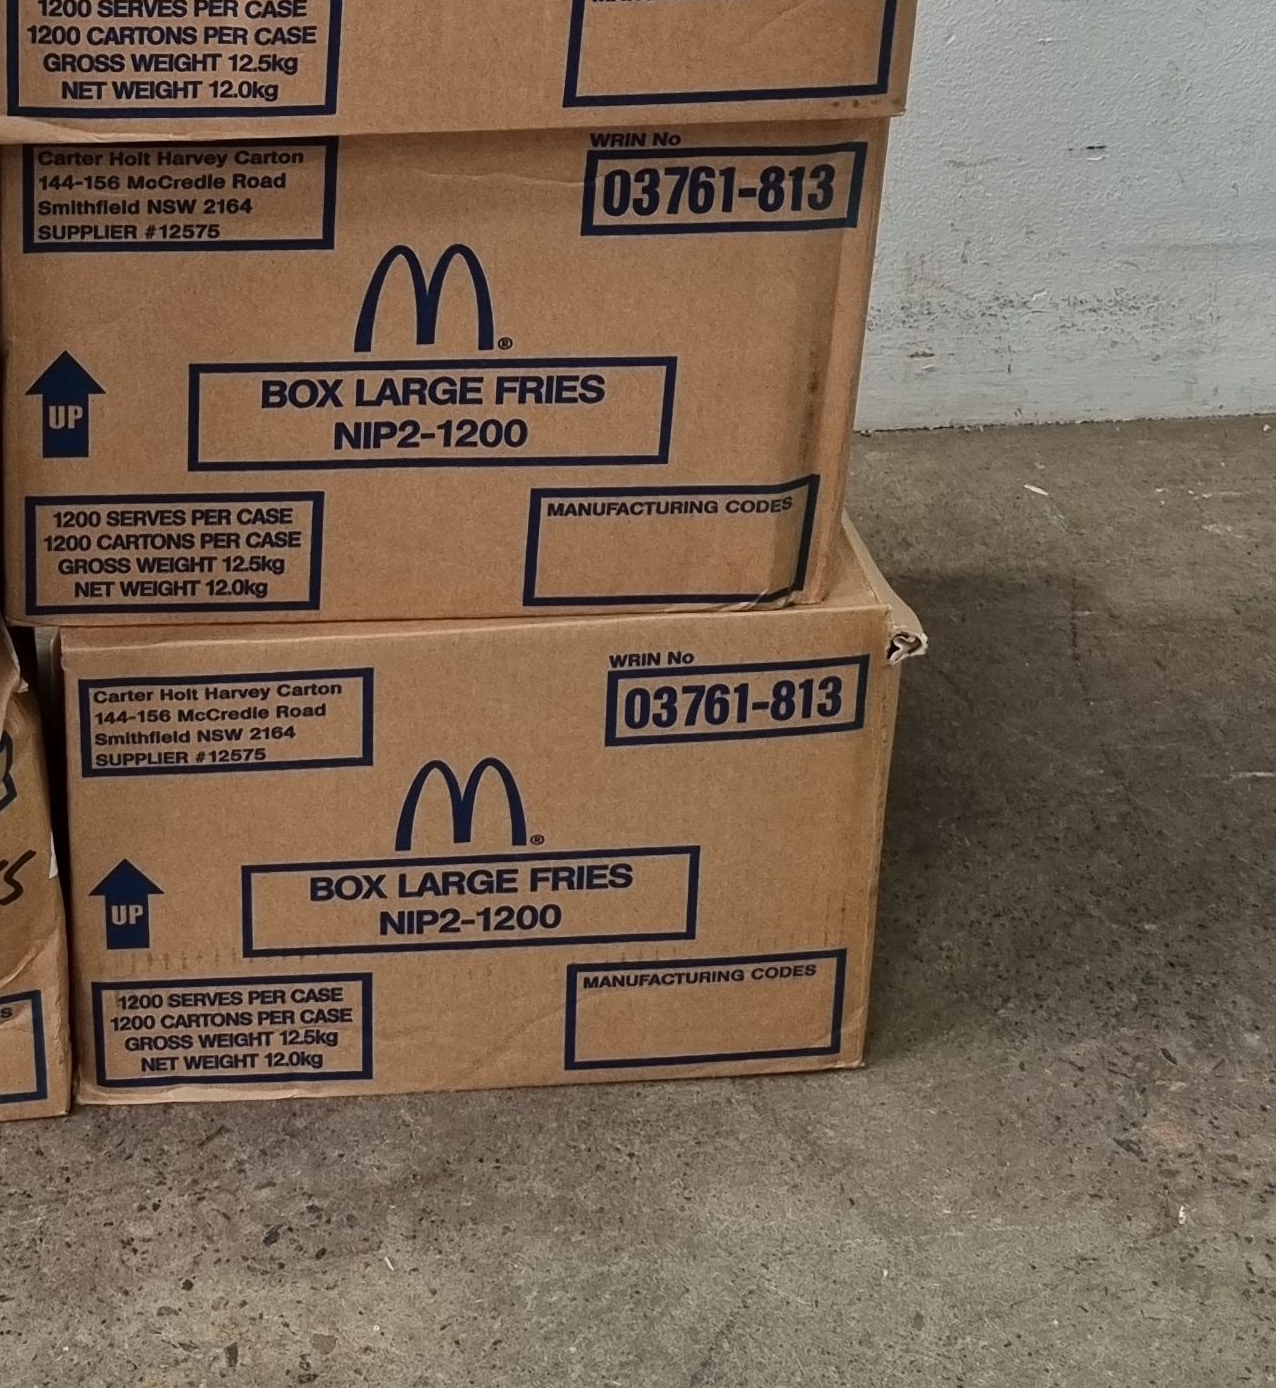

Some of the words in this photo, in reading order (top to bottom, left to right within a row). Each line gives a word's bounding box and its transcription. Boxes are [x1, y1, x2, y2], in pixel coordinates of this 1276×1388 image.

[97, 0, 187, 18] SERVES
[194, 0, 238, 18] PER
[245, 0, 307, 18] CASE
[27, 26, 80, 45] 1200
[87, 26, 197, 45] CARTONS
[203, 27, 248, 45] PER
[255, 27, 317, 45] CASE
[43, 54, 124, 72] GROSS
[131, 54, 222, 72] WEIGHT
[228, 55, 298, 75] 12.5kg
[62, 81, 106, 99] NET
[113, 81, 202, 99] WEIGHT
[209, 81, 278, 101] 12.0kg
[590, 133, 646, 147] WRIN
[652, 132, 681, 147] No
[37, 151, 102, 167] Carter
[110, 152, 150, 166] Holt
[157, 151, 227, 169] Harvey
[234, 150, 304, 164] Carton
[38, 175, 119, 191] 144-156
[127, 175, 225, 190] McCredie
[233, 173, 286, 189] Road
[602, 164, 836, 217] 03761-813
[37, 200, 139, 216] Smithfield
[147, 200, 197, 214] NSW
[203, 199, 253, 214] 2164
[38, 225, 137, 240] SUPPLIER
[145, 224, 220, 239] #12575
[261, 378, 343, 409] BOX
[355, 376, 484, 408] LARGE
[495, 374, 606, 405] FRIES
[48, 405, 83, 429] UP
[333, 419, 529, 450] NIP2-1200
[547, 500, 718, 518] MANUFACTURING
[725, 496, 793, 513] CODES
[53, 511, 101, 528] 1200
[106, 510, 186, 526] SERVES
[192, 509, 231, 525] PER
[237, 508, 293, 524] CASE
[43, 535, 91, 551] 1200
[97, 534, 195, 550] CARTONS
[201, 533, 240, 549] PER
[246, 532, 302, 548] CASE
[58, 558, 131, 574] GROSS
[136, 557, 217, 574] WEIGHT
[222, 556, 285, 574] 12.5kg
[74, 581, 114, 598] NET
[120, 580, 200, 597] WEIGHT
[206, 580, 268, 599] 12.0kg
[609, 652, 661, 669] WRIN
[667, 650, 695, 666] No
[93, 690, 153, 704] Carter
[160, 688, 198, 701] Holt
[205, 686, 270, 701] Harvey
[277, 683, 342, 697] Carton
[624, 676, 843, 730] 03761-813
[95, 710, 171, 725] 144-156
[178, 706, 269, 723] McCredie
[276, 704, 326, 718] Road
[95, 731, 191, 746] Smithfield
[197, 728, 243, 742] NSW
[250, 726, 296, 740] 2164
[95, 751, 188, 767] SUPPLIER
[195, 748, 266, 763] #12575
[310, 875, 387, 901] BOX
[398, 869, 519, 898] LARGE
[530, 864, 634, 892] FRIES
[111, 904, 143, 926] UP
[379, 904, 562, 936] NIP2-1200
[583, 968, 745, 990] MANUFACTURING
[751, 964, 818, 980] CODES
[119, 994, 163, 1010] 1200
[168, 992, 243, 1008] SERVES
[248, 990, 285, 1005] PER
[291, 987, 343, 1003] CASE
[110, 1015, 155, 1031] 1200
[161, 1012, 253, 1029] CARTONS
[258, 1010, 295, 1025] PER
[300, 1008, 352, 1023] CASE
[125, 1034, 193, 1051] GROSS
[198, 1032, 273, 1049] WEIGHT
[279, 1031, 338, 1047] 12.5kg
[141, 1057, 178, 1072] NET
[184, 1054, 259, 1070] WEIGHT
[264, 1052, 323, 1069] 12.0kg
